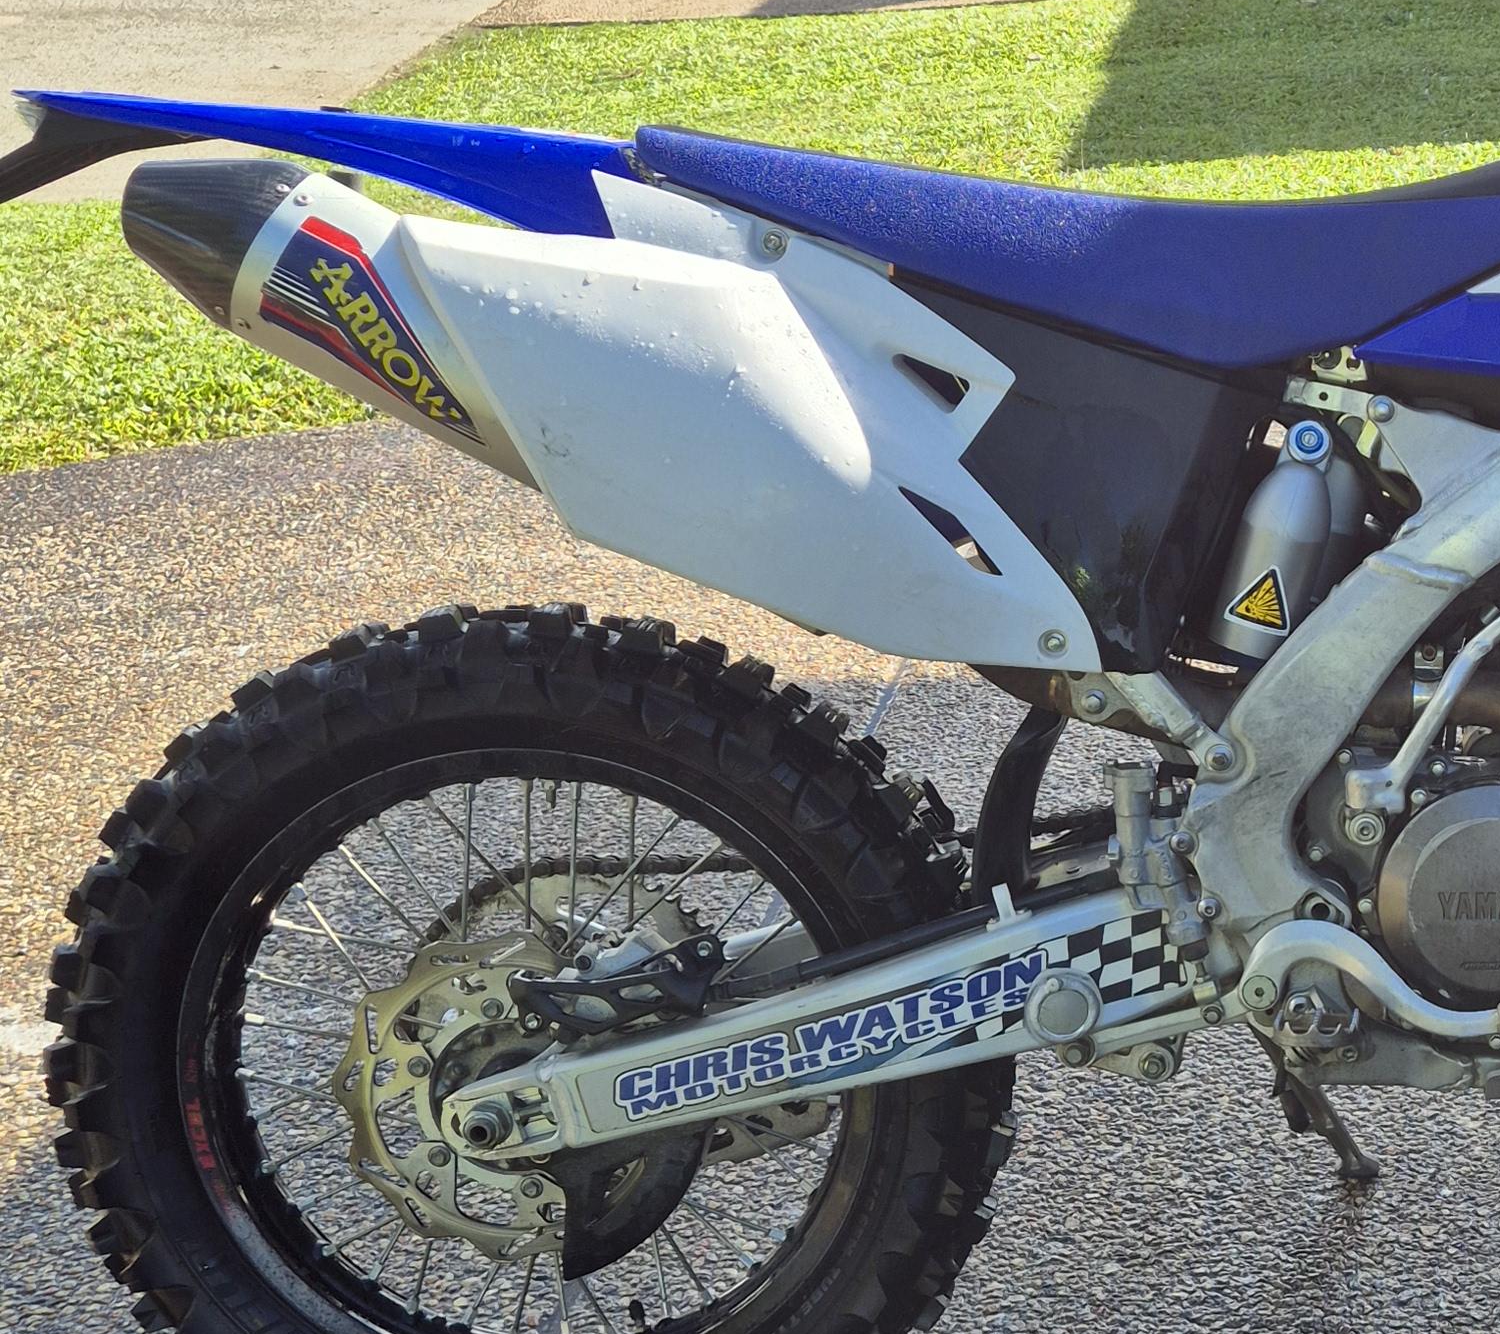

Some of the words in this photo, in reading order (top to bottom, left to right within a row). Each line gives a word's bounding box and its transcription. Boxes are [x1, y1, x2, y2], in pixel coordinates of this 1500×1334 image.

[309, 257, 462, 419] ARROW
[619, 1035, 786, 1102] CHRIS
[799, 954, 1043, 1047] WATSON
[630, 987, 1031, 1115] MOTORCYCLES
